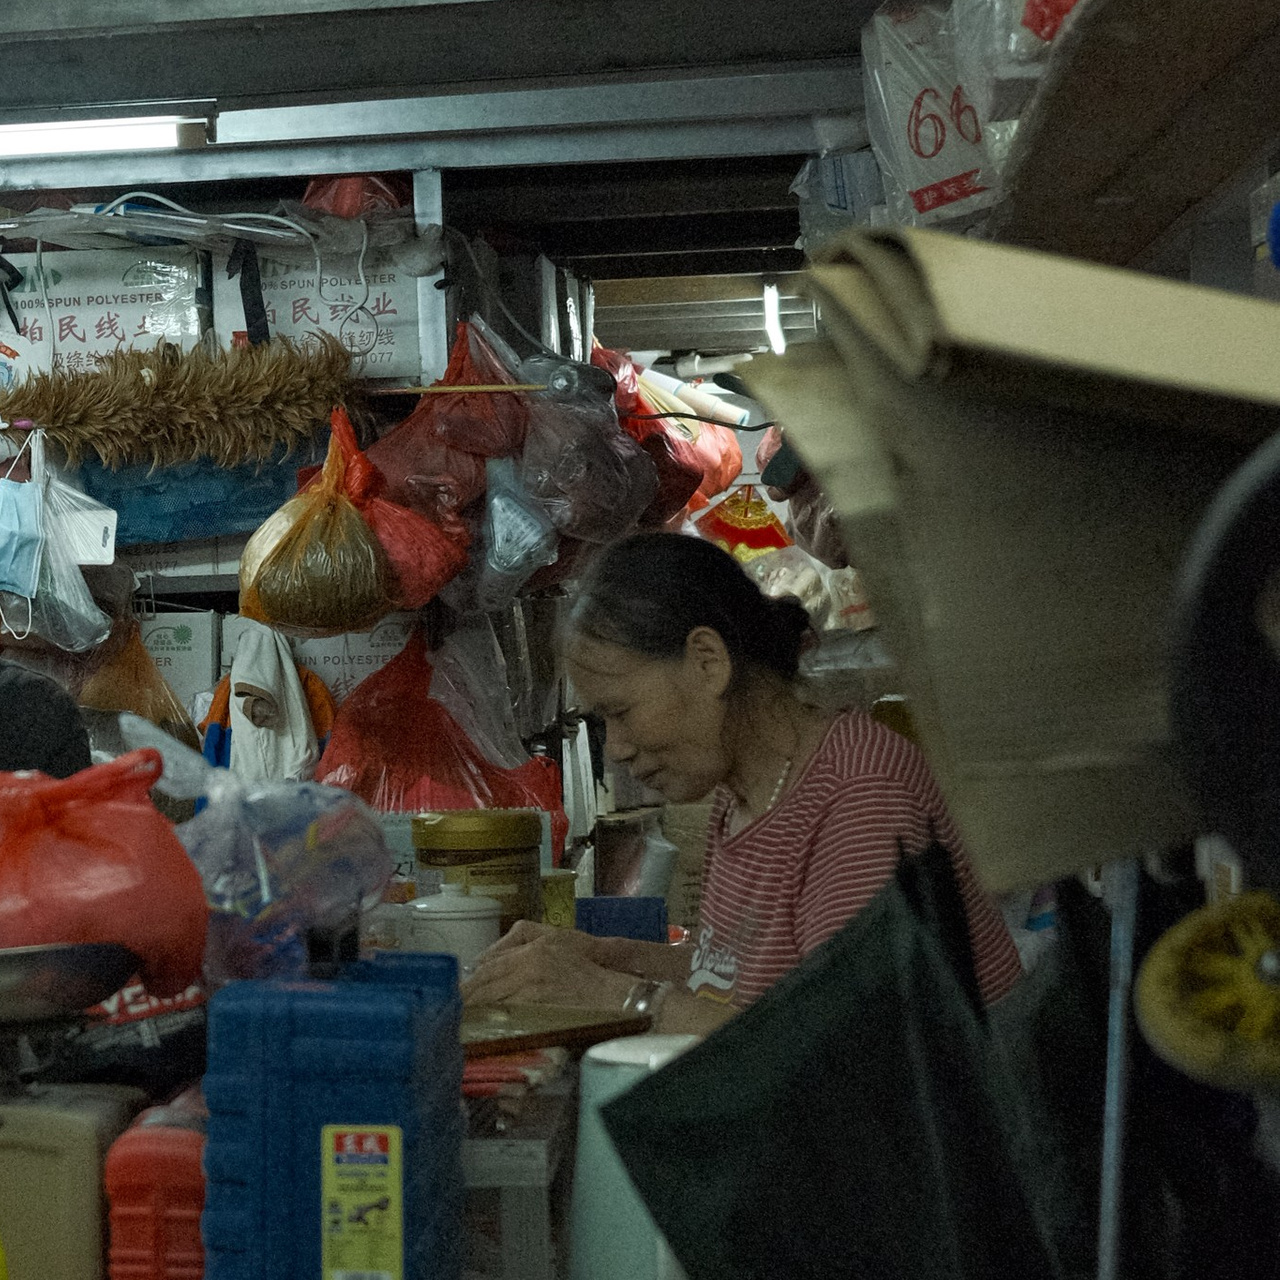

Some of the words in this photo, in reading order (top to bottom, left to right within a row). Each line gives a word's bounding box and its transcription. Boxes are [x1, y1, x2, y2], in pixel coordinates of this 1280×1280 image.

[280, 278, 315, 291] SPUN
[321, 273, 397, 287] POLYESTER
[86, 291, 164, 307] POLYESTER
